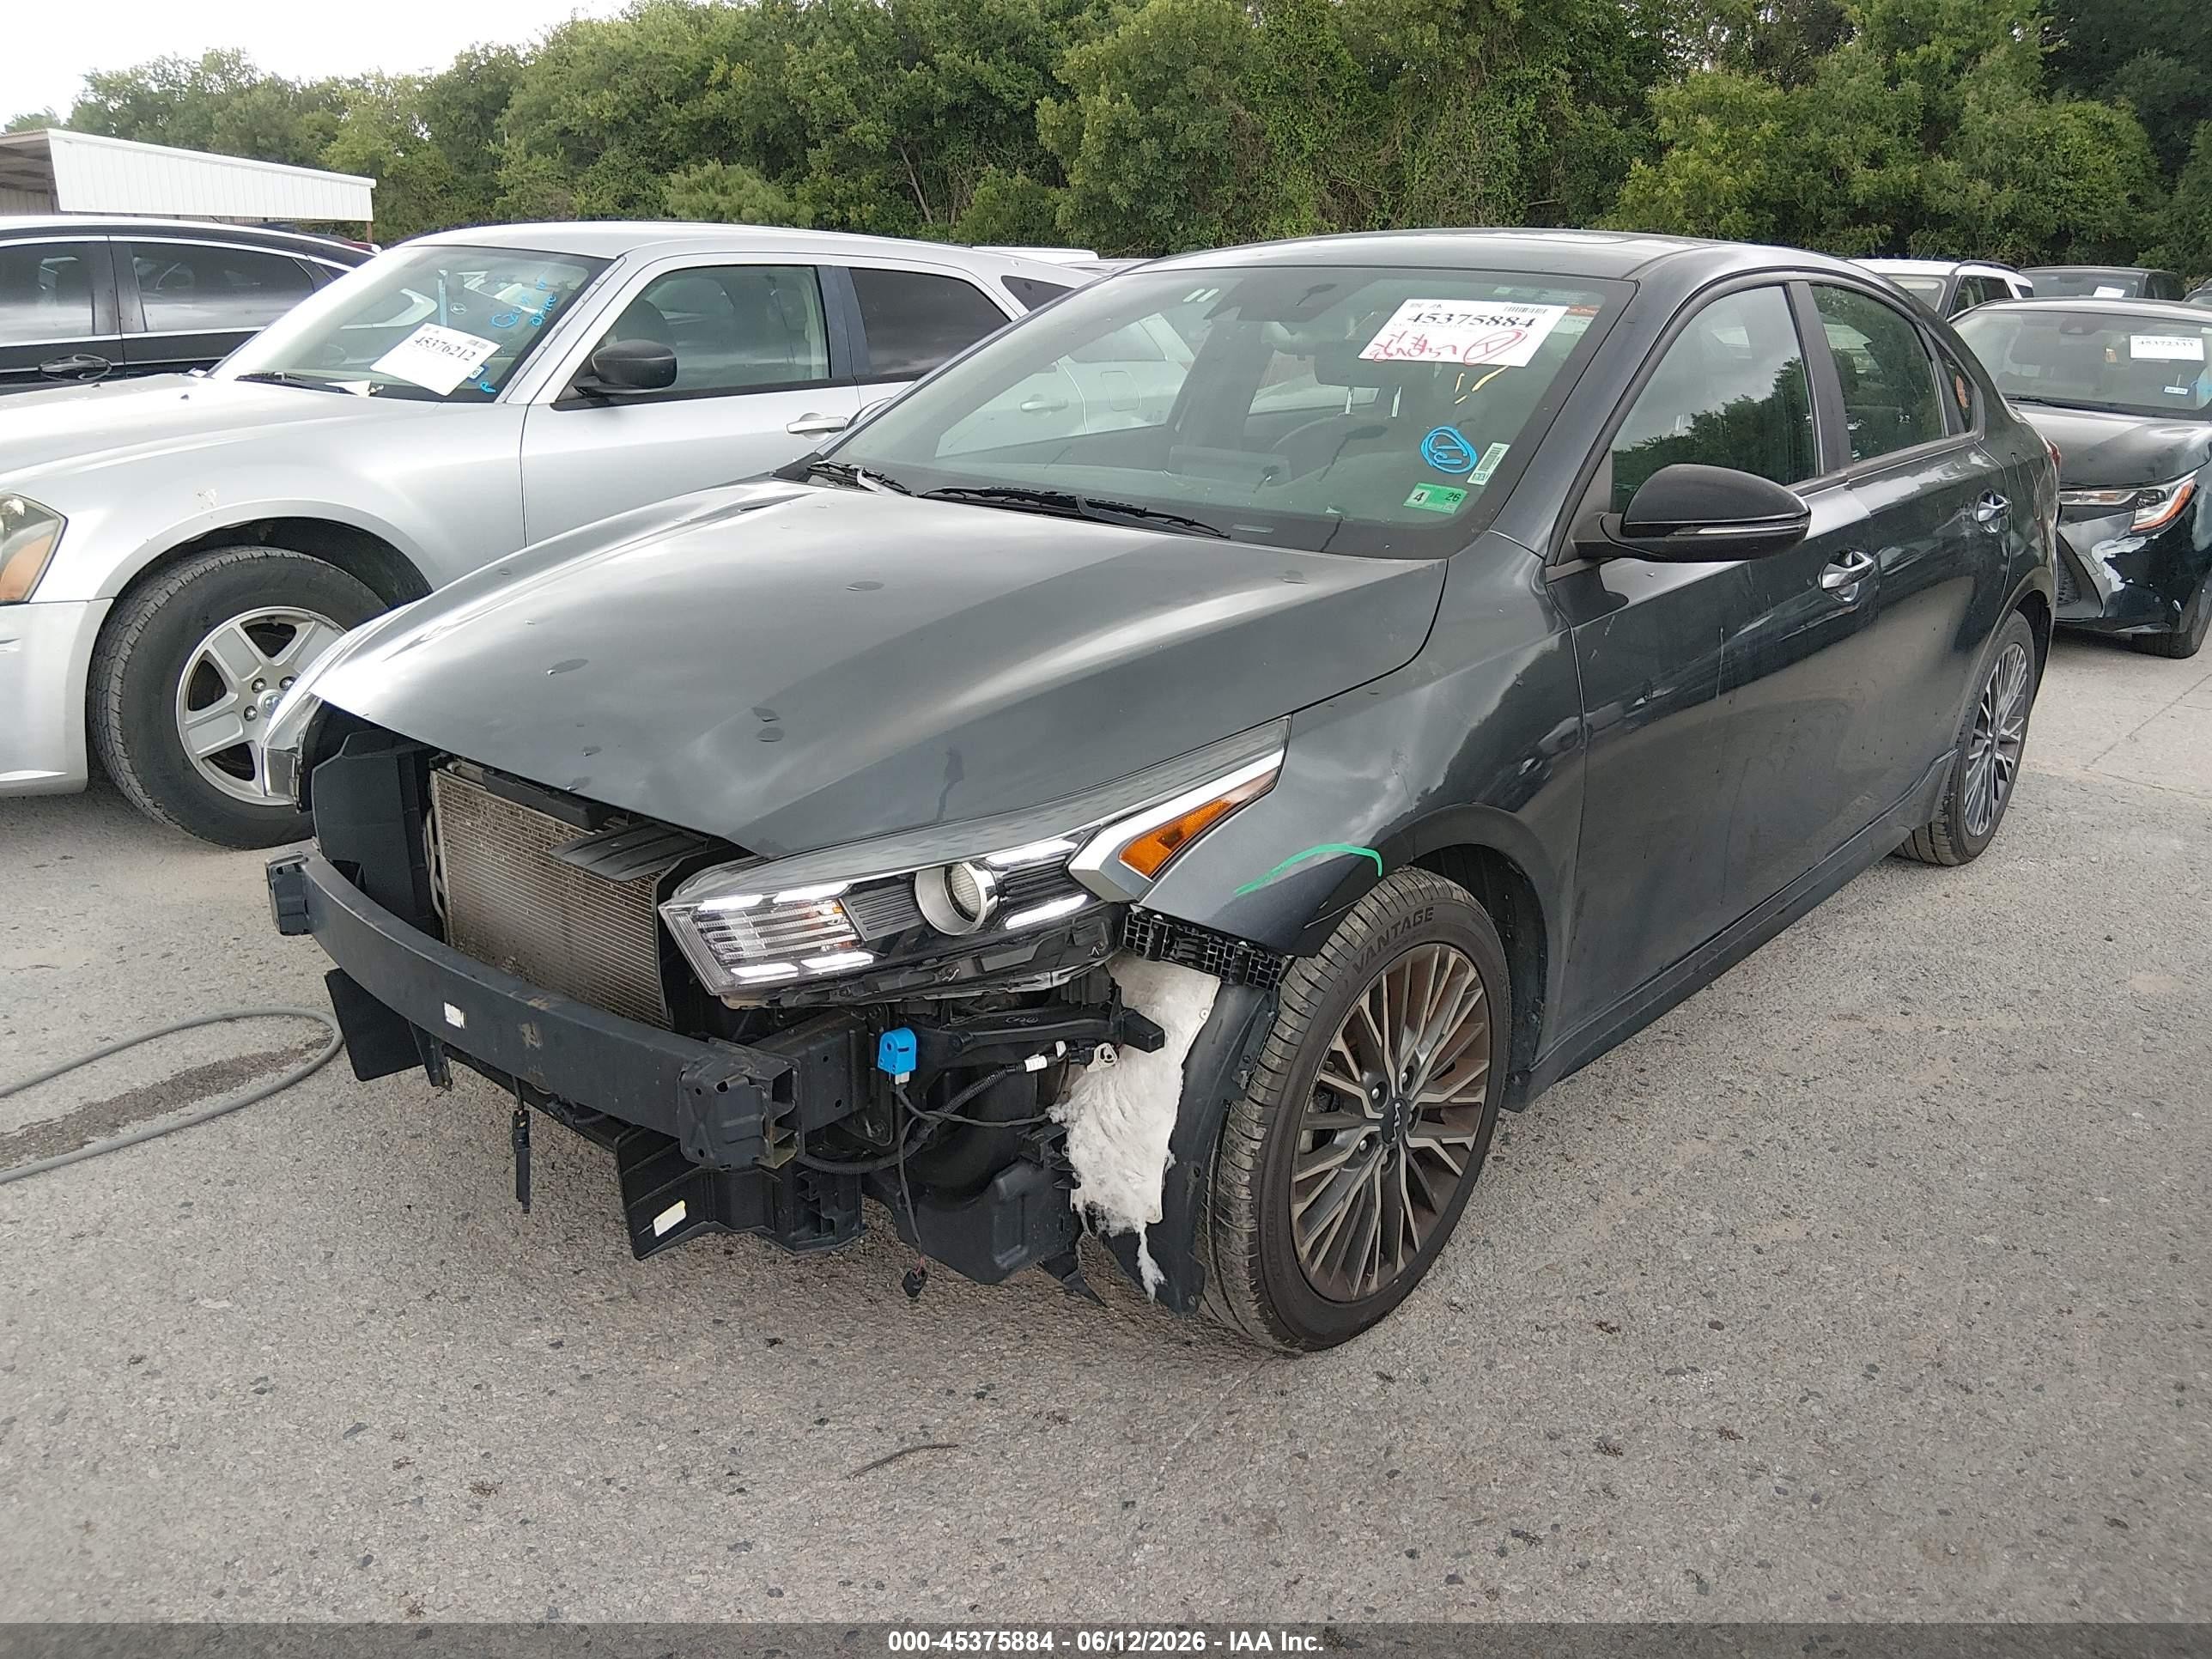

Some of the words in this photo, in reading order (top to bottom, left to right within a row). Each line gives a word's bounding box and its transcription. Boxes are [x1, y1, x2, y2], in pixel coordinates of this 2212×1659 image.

[1407, 312, 1536, 328] 45375884
[414, 337, 477, 362] 45376212
[1413, 492, 1424, 502] 4
[1445, 492, 1462, 502] 26
[1352, 906, 1435, 974] VANTAGE
